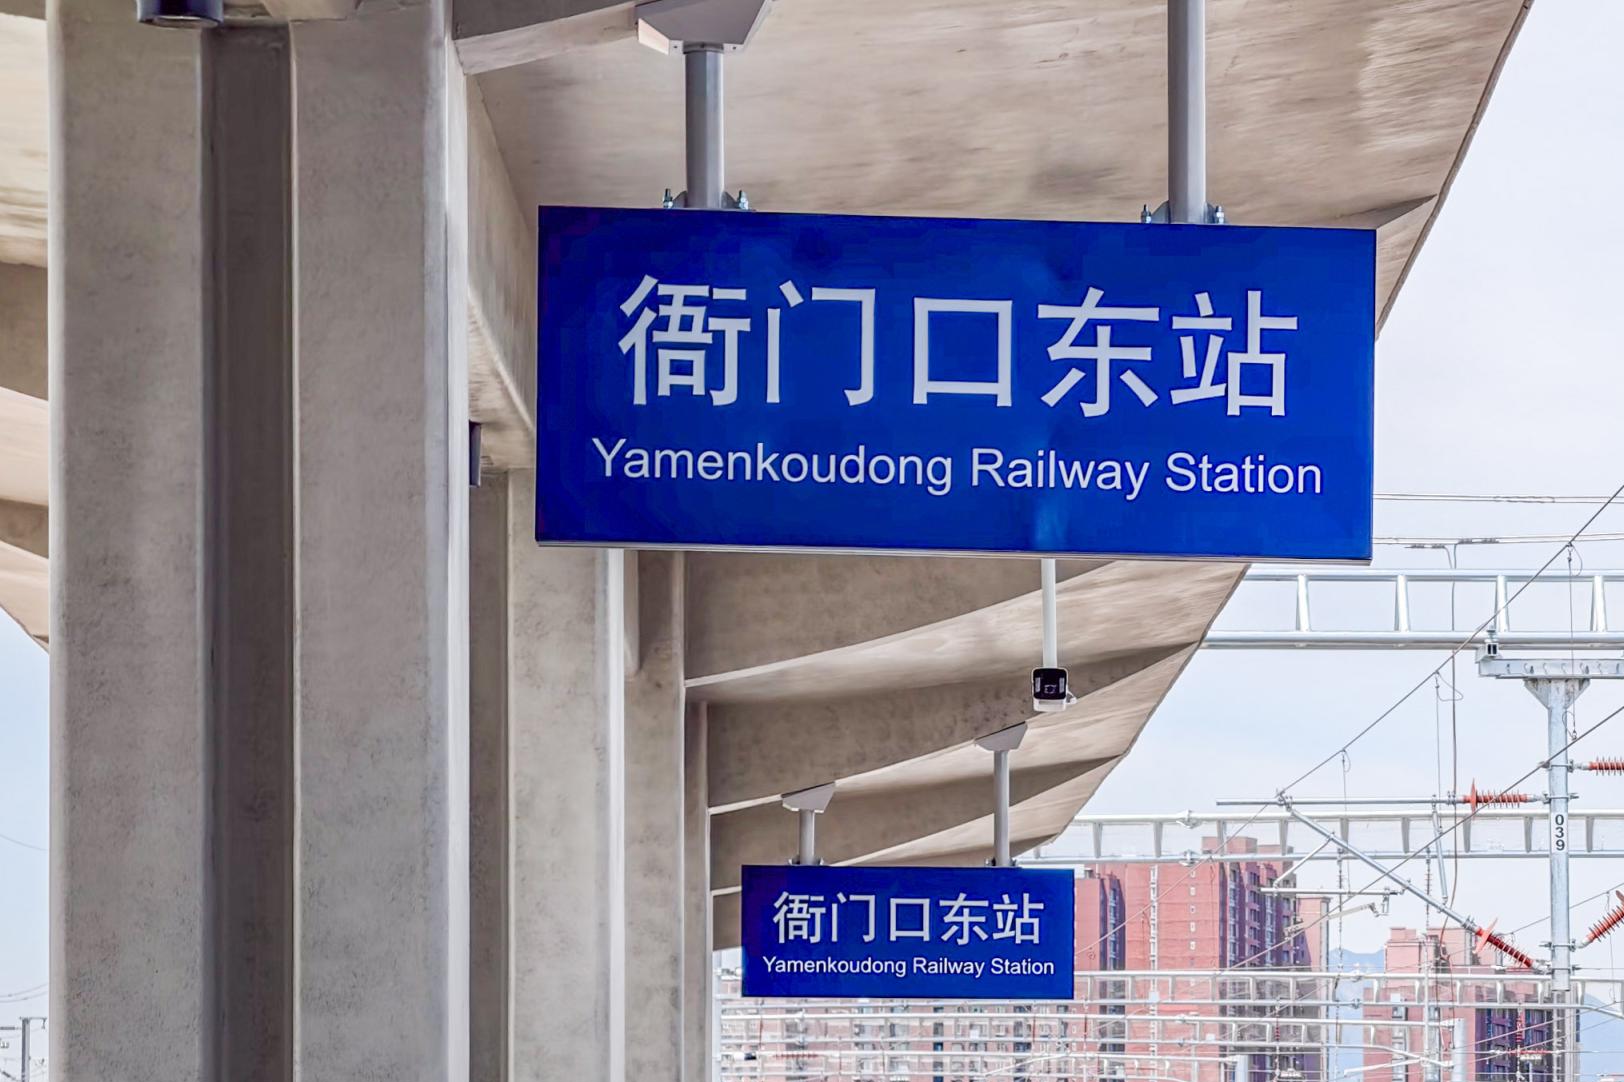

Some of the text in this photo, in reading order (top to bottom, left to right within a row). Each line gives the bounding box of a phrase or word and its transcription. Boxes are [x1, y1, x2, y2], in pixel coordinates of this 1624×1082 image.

[618, 274, 1299, 418] 衙门口东站
[592, 437, 1322, 501] Yamenkoudong Railway Station
[1554, 814, 1566, 852] 039
[772, 891, 1045, 946] 衙门口东站
[763, 956, 1055, 979] Yamenkoudong Railway Station
